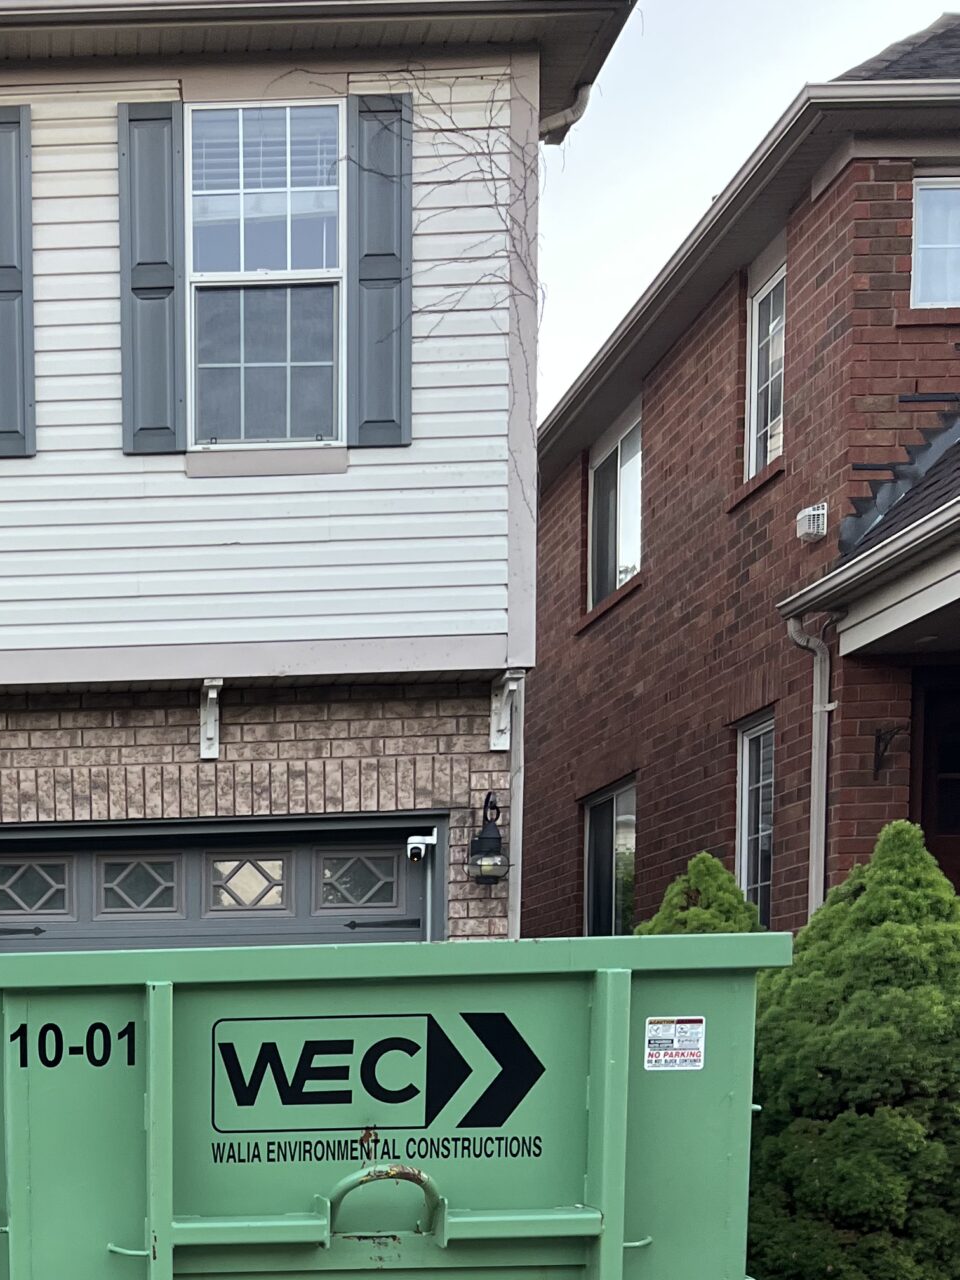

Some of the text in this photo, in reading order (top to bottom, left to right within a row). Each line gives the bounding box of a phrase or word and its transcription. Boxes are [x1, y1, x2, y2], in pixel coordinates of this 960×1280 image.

[10, 1022, 135, 1067] 10-01
[217, 1036, 422, 1107] WEC
[211, 1136, 543, 1164] WALIA ENVIRONMENTAL CONSTRUCTIONS
